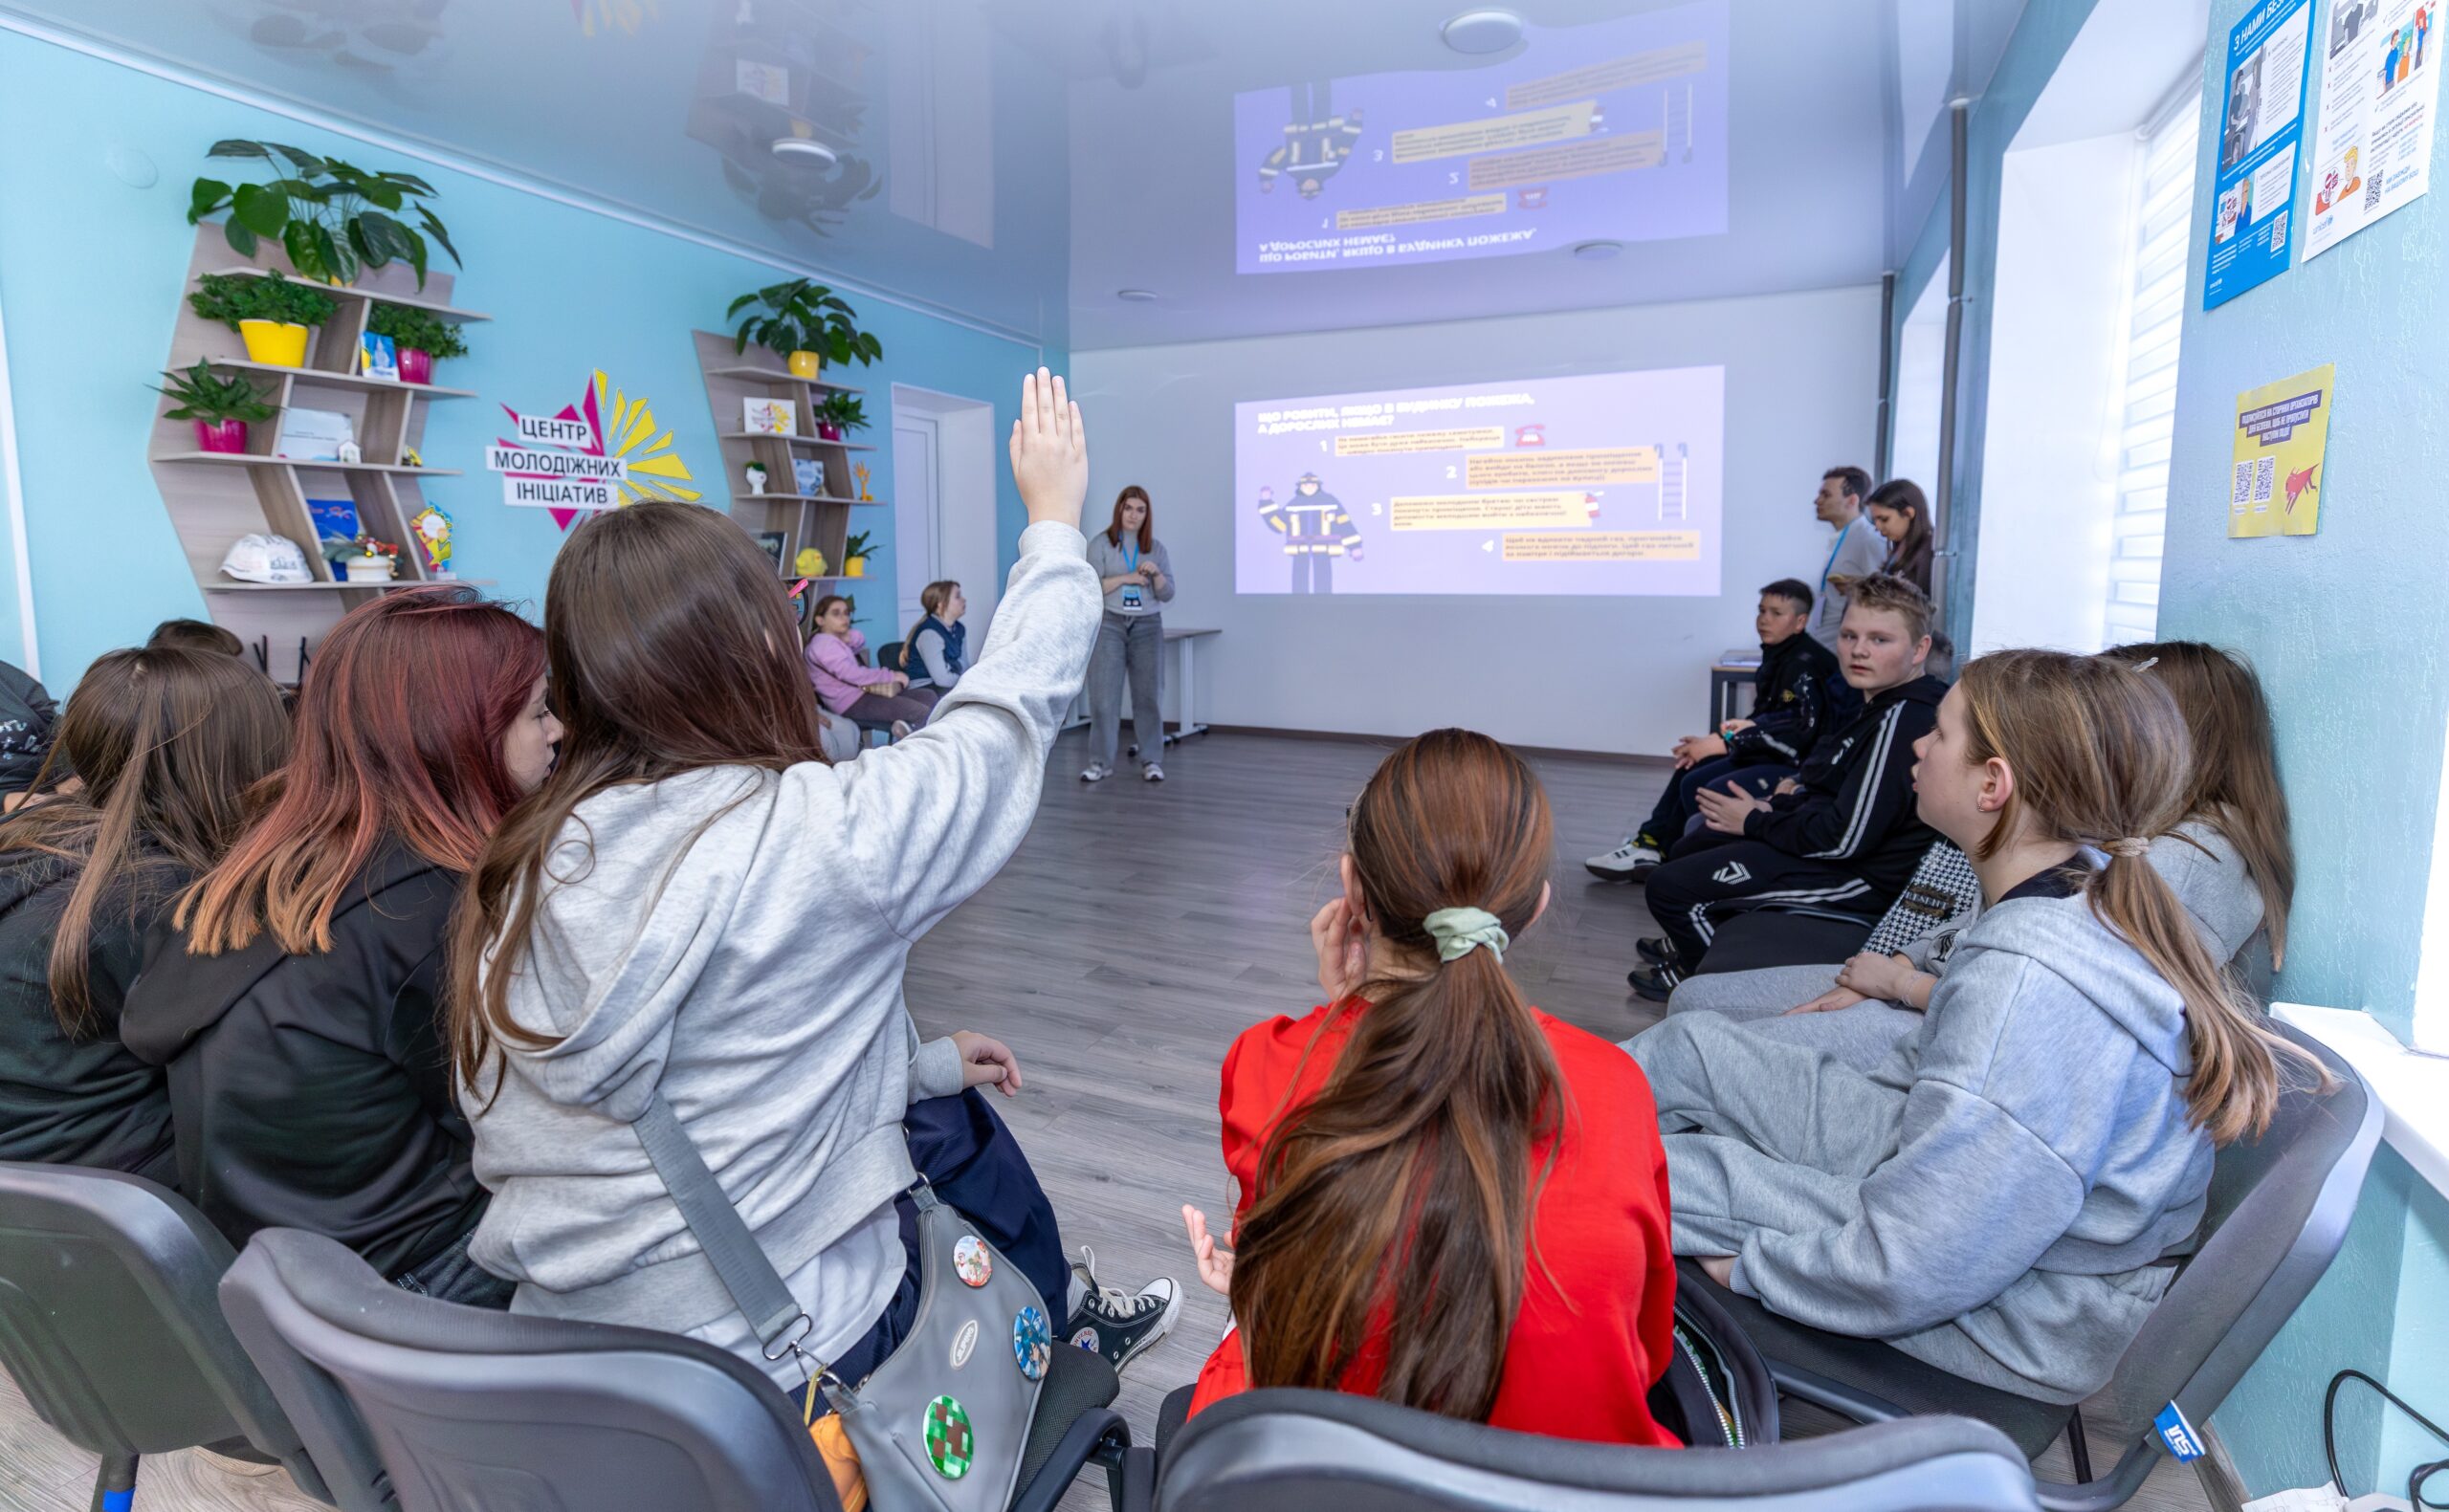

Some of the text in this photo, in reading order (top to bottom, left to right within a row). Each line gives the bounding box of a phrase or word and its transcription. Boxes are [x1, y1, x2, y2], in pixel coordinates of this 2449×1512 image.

[2240, 8, 2266, 45] НАМИ
[1258, 410, 1282, 423] ЩО
[521, 418, 587, 441] ЦЕНТР
[1258, 423, 1268, 434] А
[1269, 419, 1340, 435] ДОРОСЛИХ
[1320, 439, 1328, 452] 1
[495, 450, 622, 478] МОЛОДІЖНИХ
[1445, 466, 1457, 478] 2
[517, 482, 608, 504] ІНІЦІАТИВ
[1371, 502, 1382, 515] 3
[1072, 1329, 1093, 1346] ONVERSE
